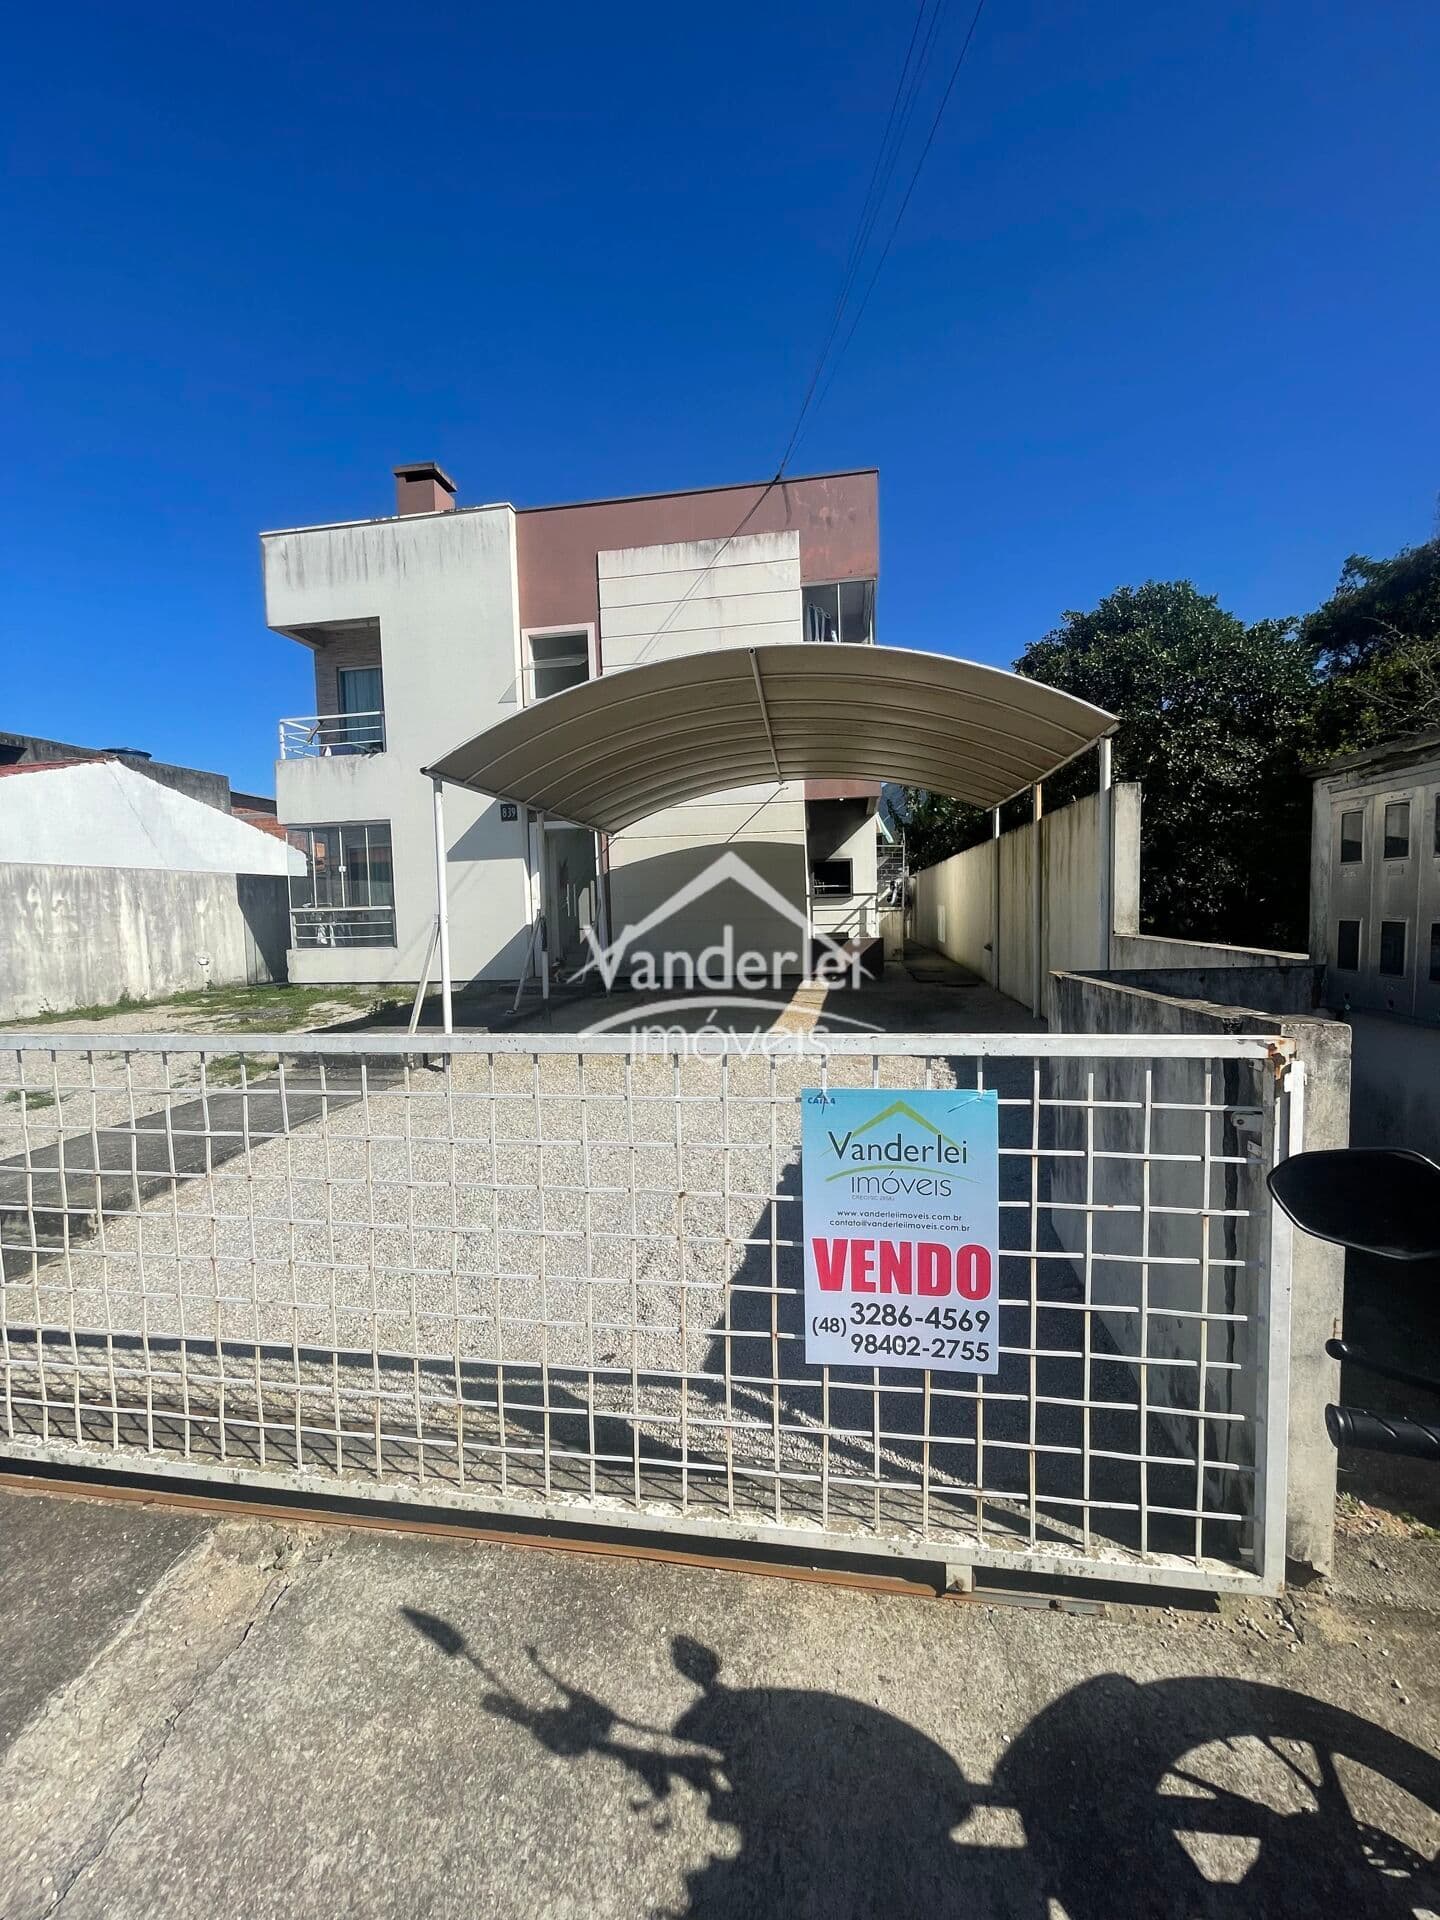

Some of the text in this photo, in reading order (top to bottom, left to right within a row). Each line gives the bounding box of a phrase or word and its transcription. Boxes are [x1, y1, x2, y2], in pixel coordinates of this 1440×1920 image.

[502, 807, 516, 818] 839
[828, 1130, 968, 1164] Vanderlei
[851, 1170, 952, 1197] imóveis
[829, 1219, 970, 1232] contato@vanderleiimoveis.com.br
[837, 1210, 962, 1221] www.vanderleiimoveis.com.br
[811, 1238, 991, 1300] VENDO
[811, 1302, 990, 1338] (48) 3286-4569
[850, 1333, 990, 1362] 98402-2755
